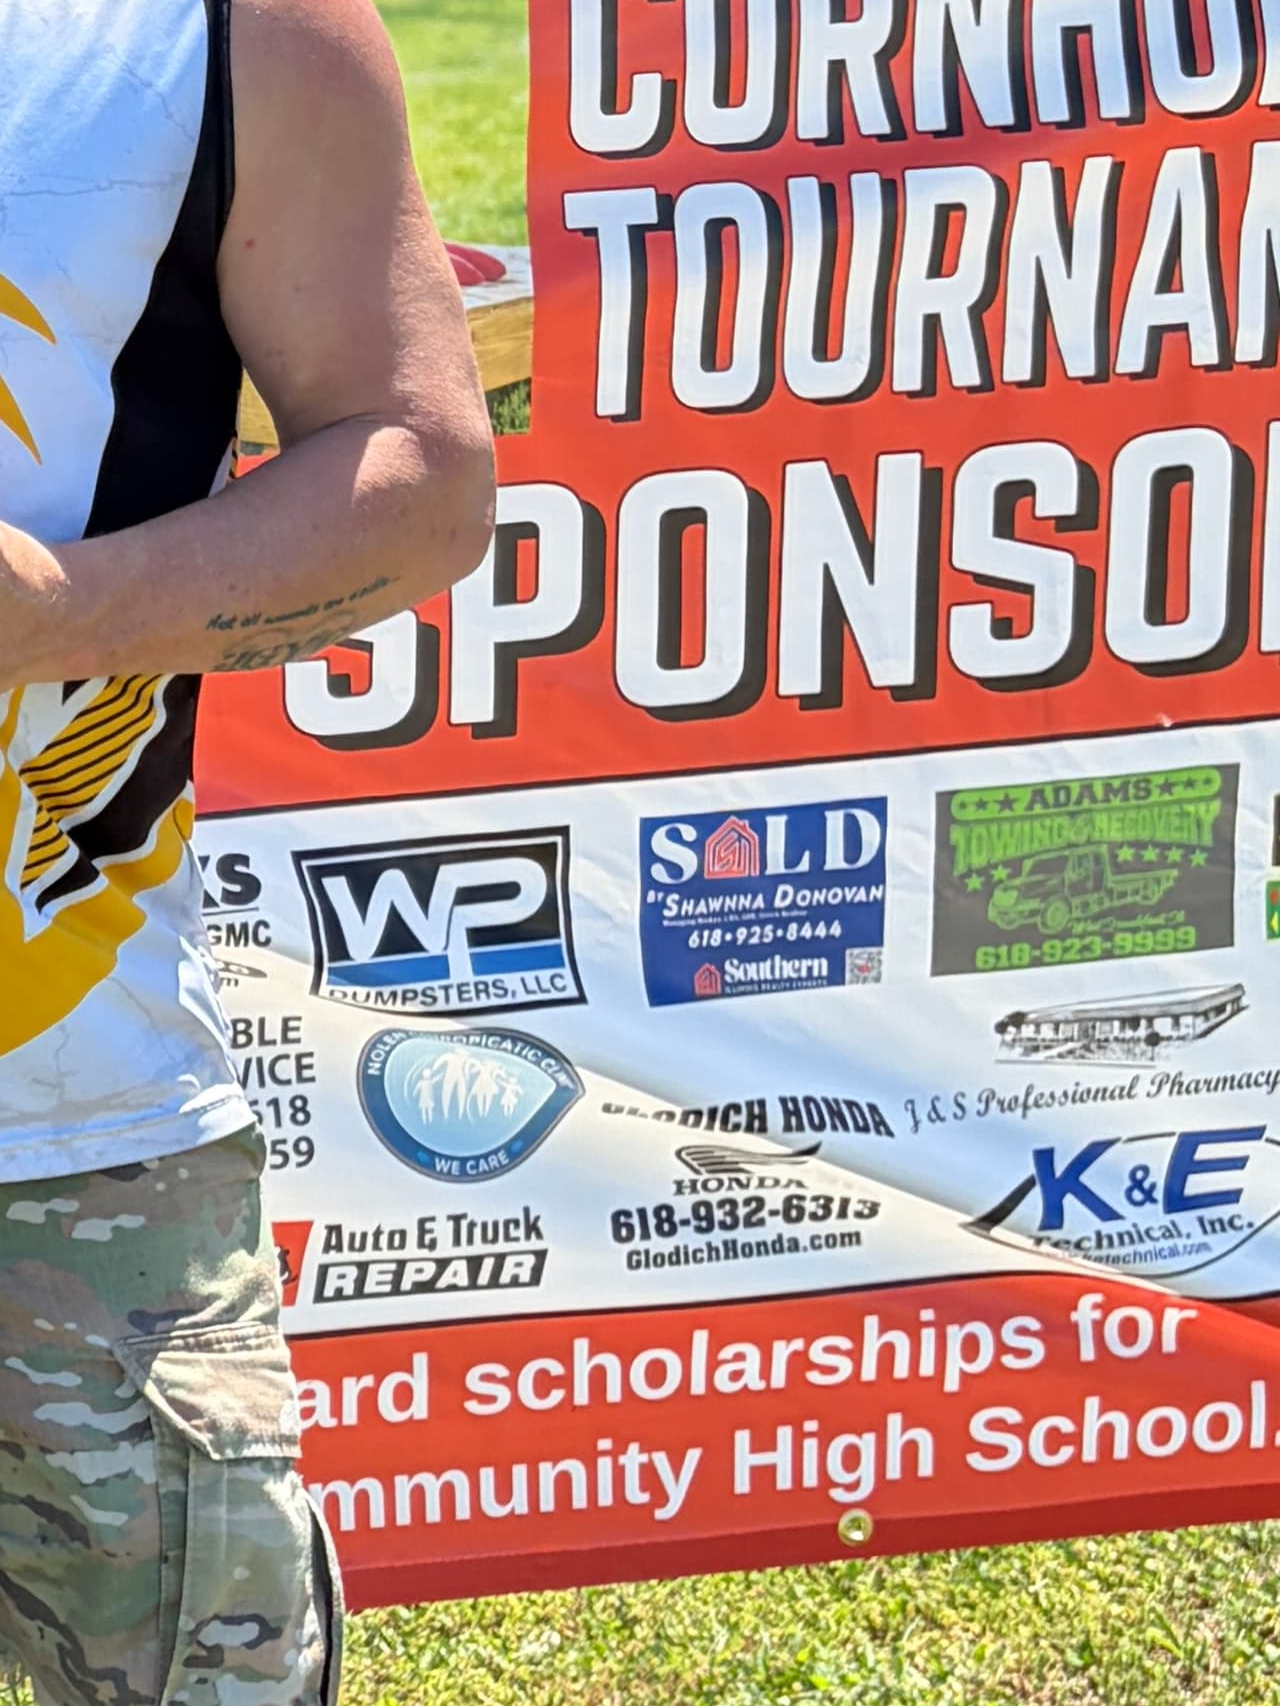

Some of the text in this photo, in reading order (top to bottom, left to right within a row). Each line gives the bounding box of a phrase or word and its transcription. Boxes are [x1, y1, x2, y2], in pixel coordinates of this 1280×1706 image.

[1026, 776, 1153, 809] ADAMS
[950, 815, 1070, 877] TOWING
[1092, 798, 1222, 846] RECOVERY
[321, 857, 547, 980] WP
[663, 893, 765, 917] SHAWNNA
[774, 884, 885, 909] DONOVAN
[207, 919, 272, 948] GMC
[975, 926, 1196, 970] 618-923-9999
[520, 972, 569, 995] LLC
[724, 954, 828, 983] Southern
[230, 1016, 302, 1049] BLE
[367, 1029, 408, 1076] NOLEN
[927, 1094, 947, 1124] &
[952, 1091, 967, 1121] S
[975, 1074, 1141, 1119] Professional
[1145, 1067, 1280, 1100] Pharmacy
[778, 1095, 896, 1139] HONDA
[269, 1136, 315, 1170] 59
[434, 1150, 510, 1175] WE CARE
[673, 1176, 809, 1196] HONDA
[321, 1223, 407, 1254] Auto
[446, 1205, 544, 1248] Truck
[610, 1194, 882, 1244] 618-932-6313
[1197, 1213, 1254, 1236] Inc.
[626, 1230, 862, 1271] GlodichHonda.com
[322, 1253, 537, 1298] REPAIR
[462, 1307, 1046, 1418] scholarships
[1069, 1293, 1196, 1363] for
[733, 1411, 936, 1505] High
[965, 1381, 1280, 1476] School.
